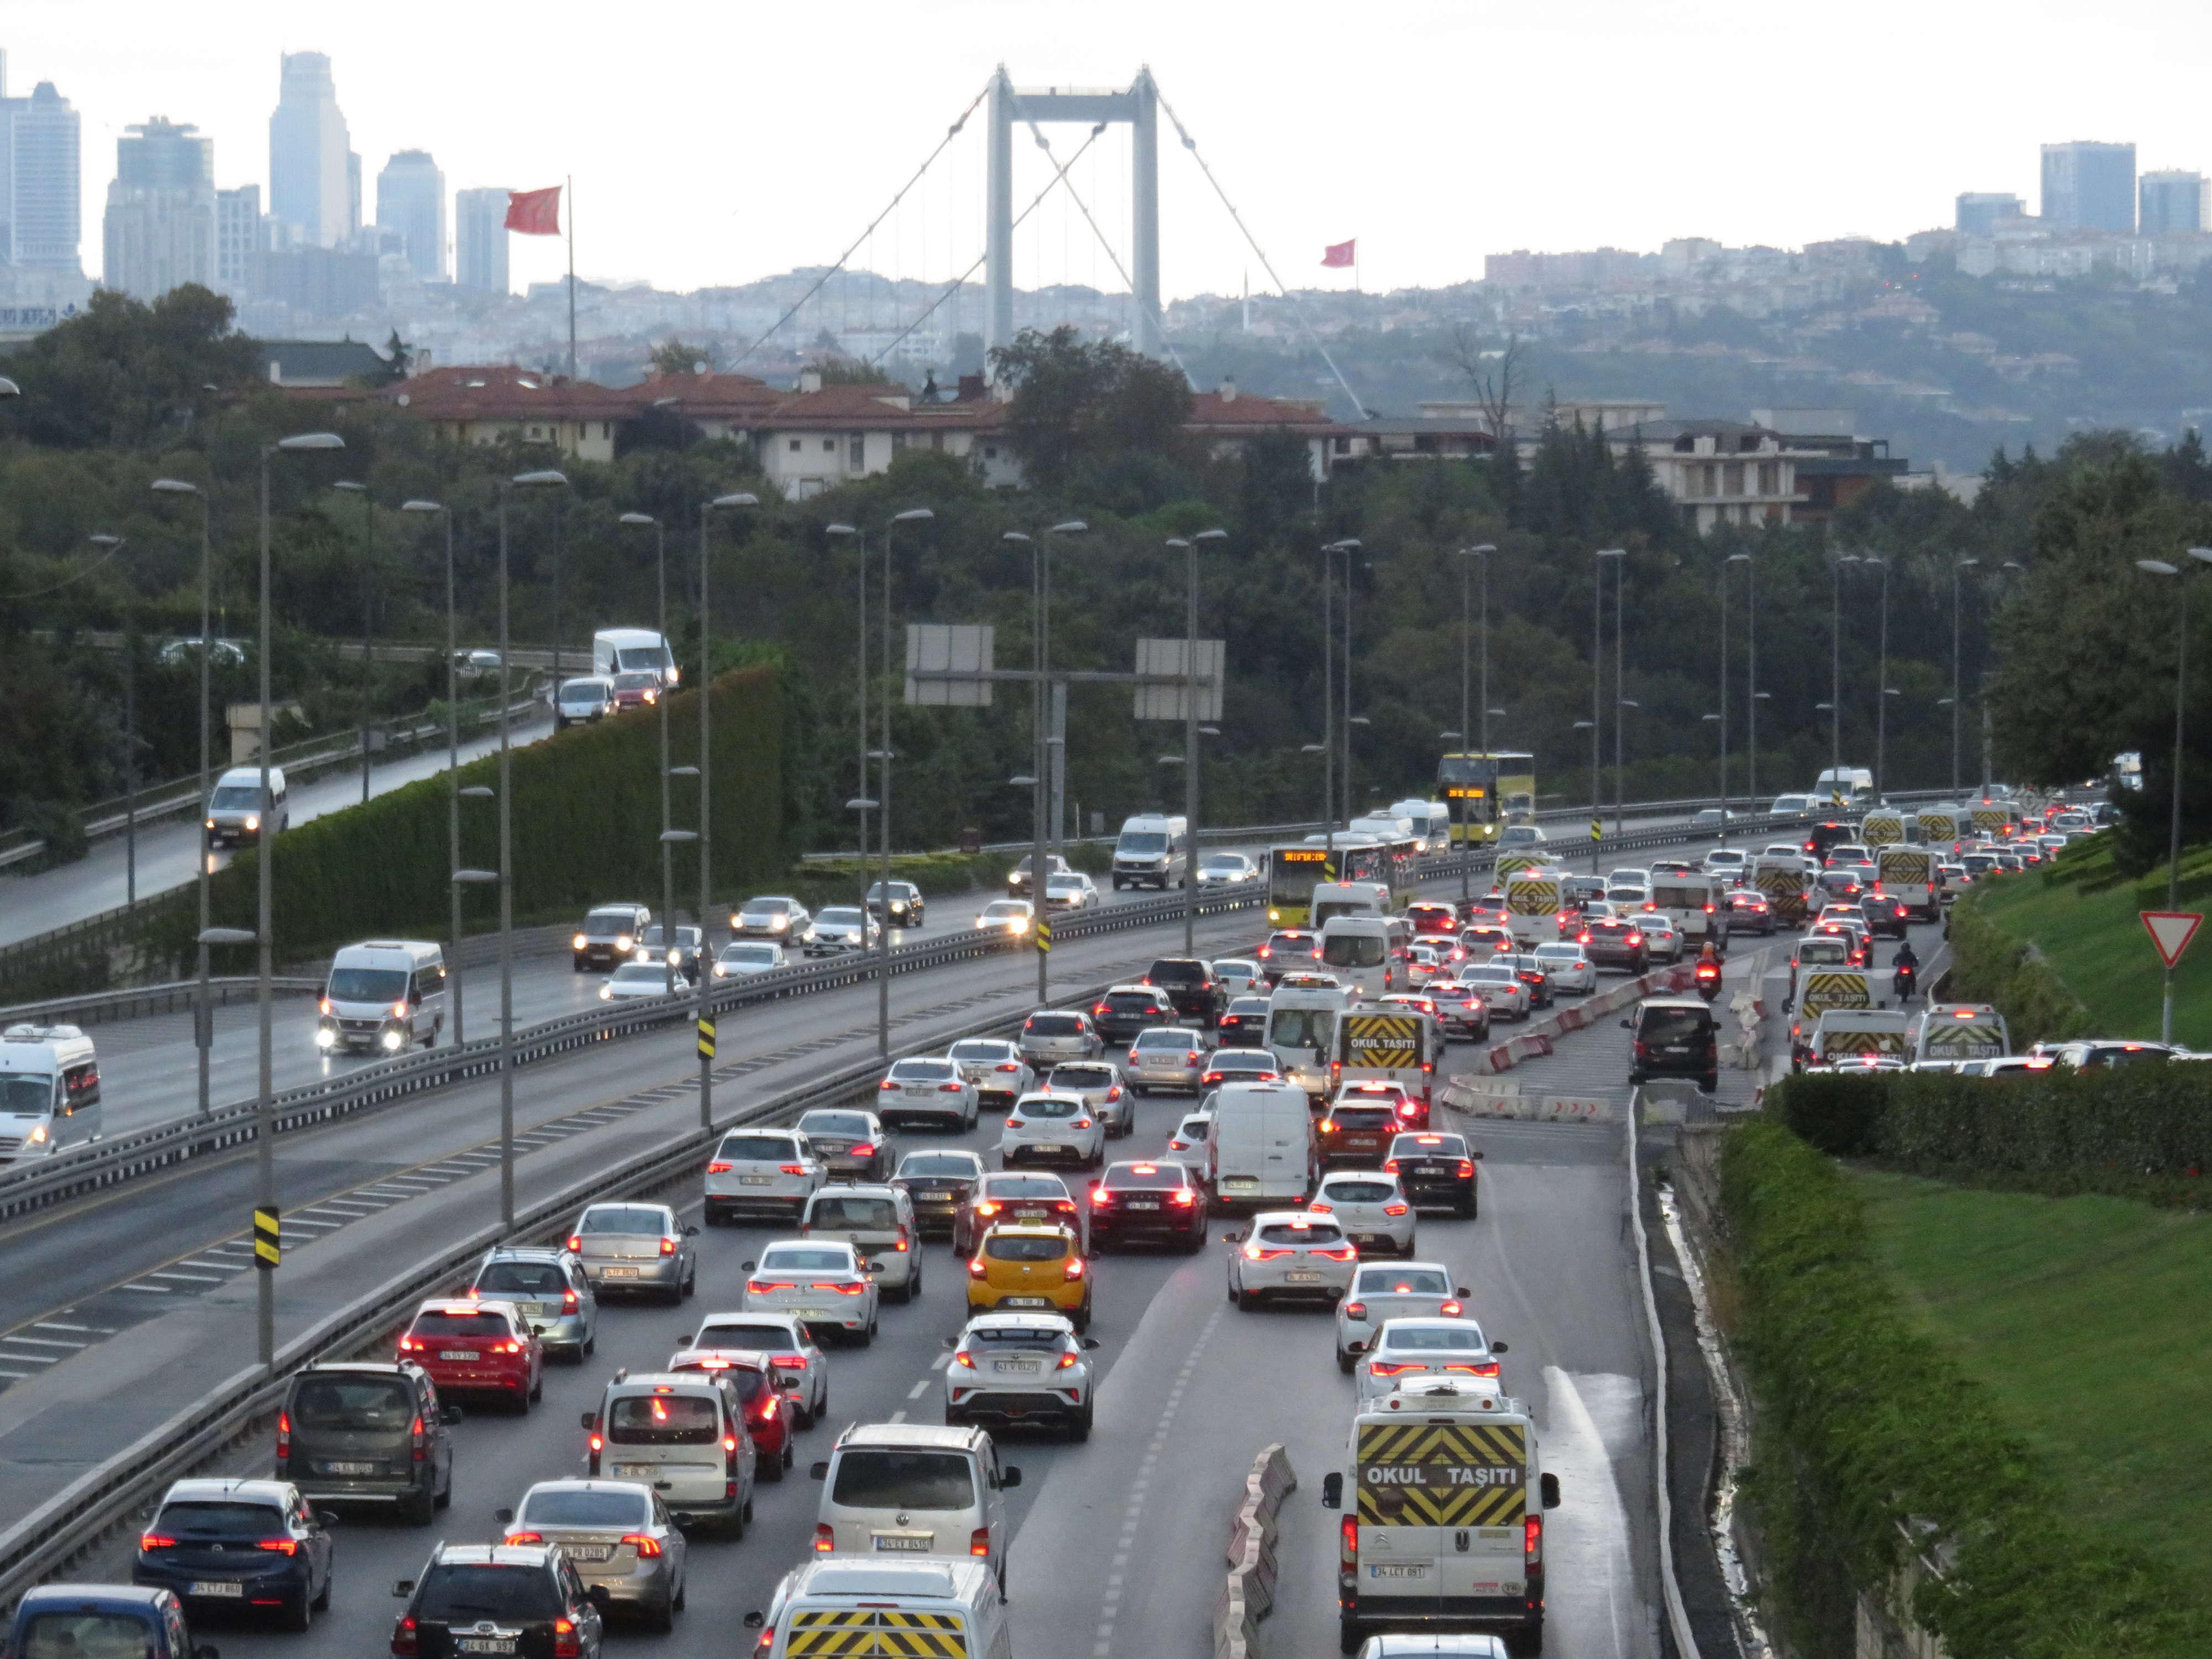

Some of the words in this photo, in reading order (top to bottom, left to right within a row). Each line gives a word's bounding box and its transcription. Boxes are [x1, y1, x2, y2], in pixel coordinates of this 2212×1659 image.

[1351, 1039, 1379, 1048] OKUL
[1929, 1045, 1959, 1056] OKUL
[1367, 1467, 1427, 1484] OKUL
[1447, 1468, 1516, 1488] TAŞITI
[883, 1539, 891, 1548] 34
[1377, 1567, 1386, 1576] 34
[1390, 1567, 1404, 1576] LCT
[1408, 1567, 1421, 1576] 091
[465, 1641, 474, 1651] 34
[496, 1641, 513, 1651] 992
